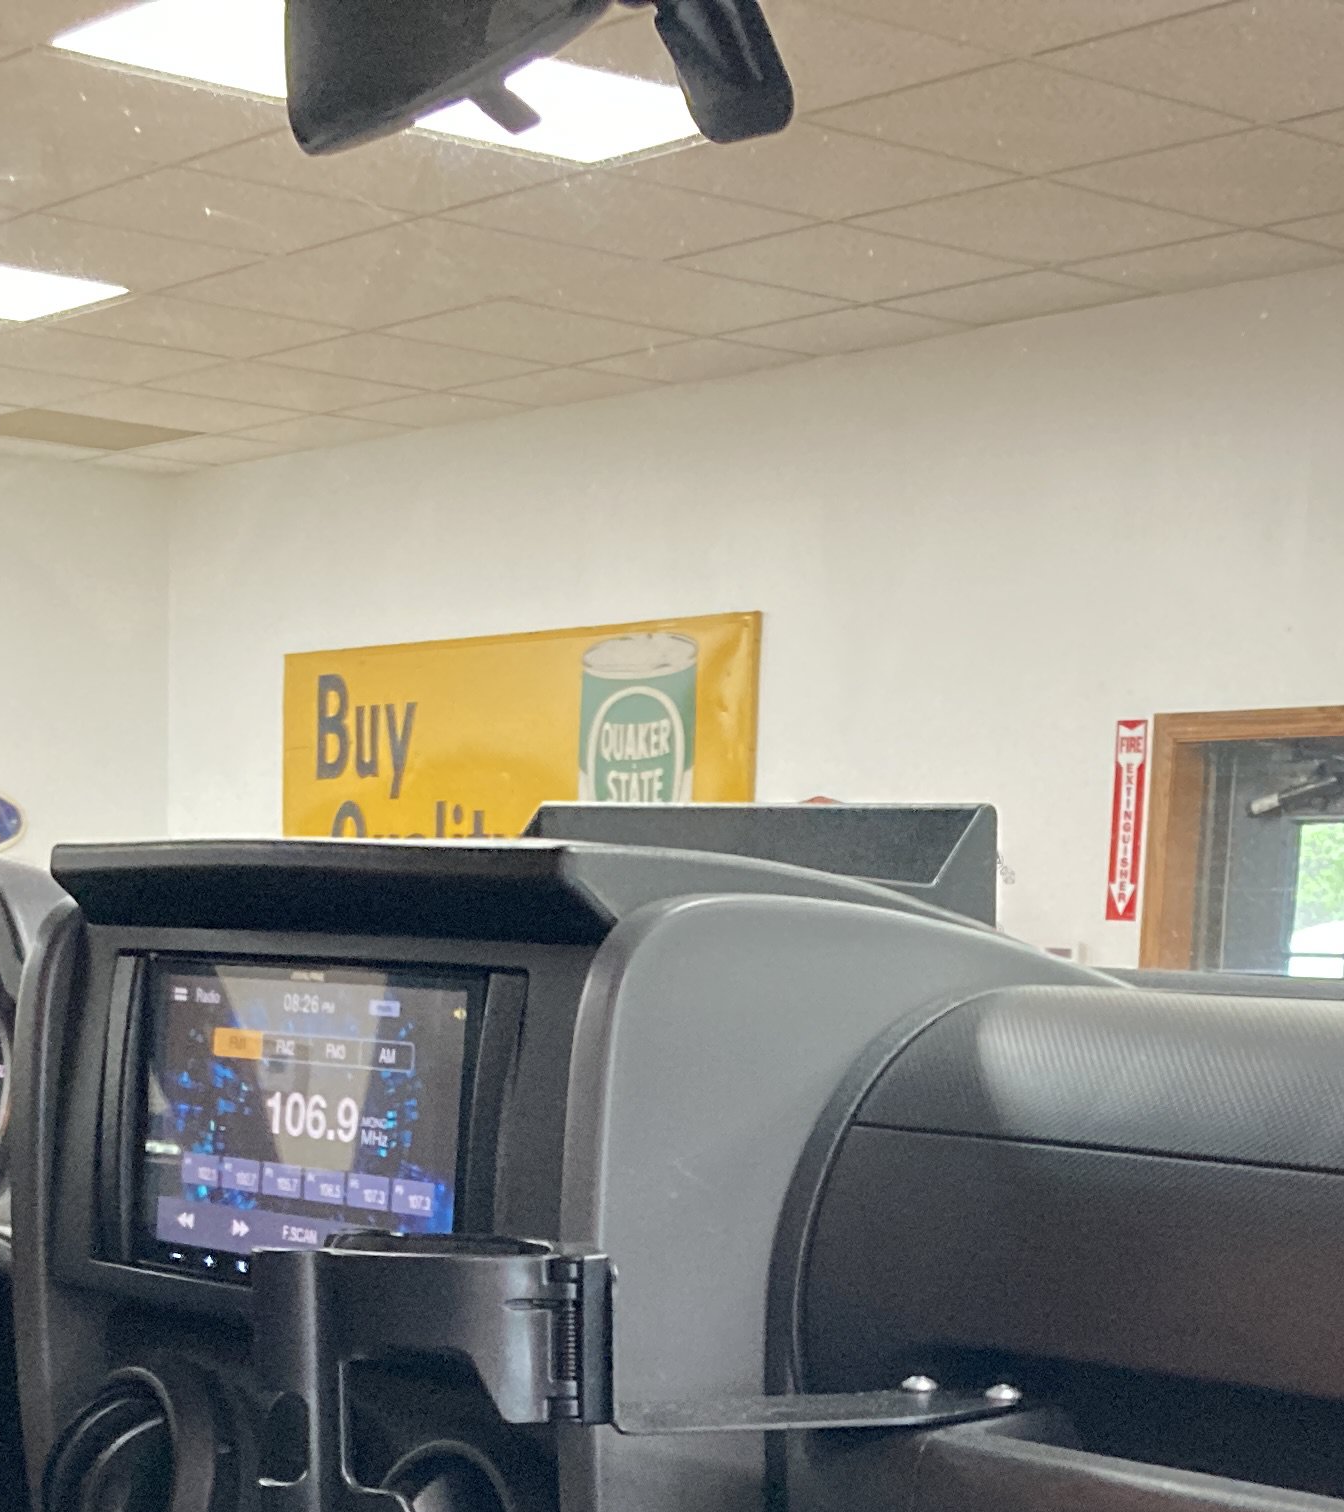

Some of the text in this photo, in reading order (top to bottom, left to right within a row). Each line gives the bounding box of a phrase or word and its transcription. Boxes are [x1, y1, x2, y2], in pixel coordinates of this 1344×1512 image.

[316, 673, 418, 799] Buy
[601, 718, 671, 762] QUAKER
[1119, 736, 1143, 753] FIRE
[607, 768, 663, 802] STATE
[1118, 762, 1134, 902] EXTINGUISHER
[284, 993, 319, 1014] 08:26
[378, 1048, 396, 1064] AM
[266, 1091, 359, 1143] 106.9
[361, 1129, 388, 1147] MHz
